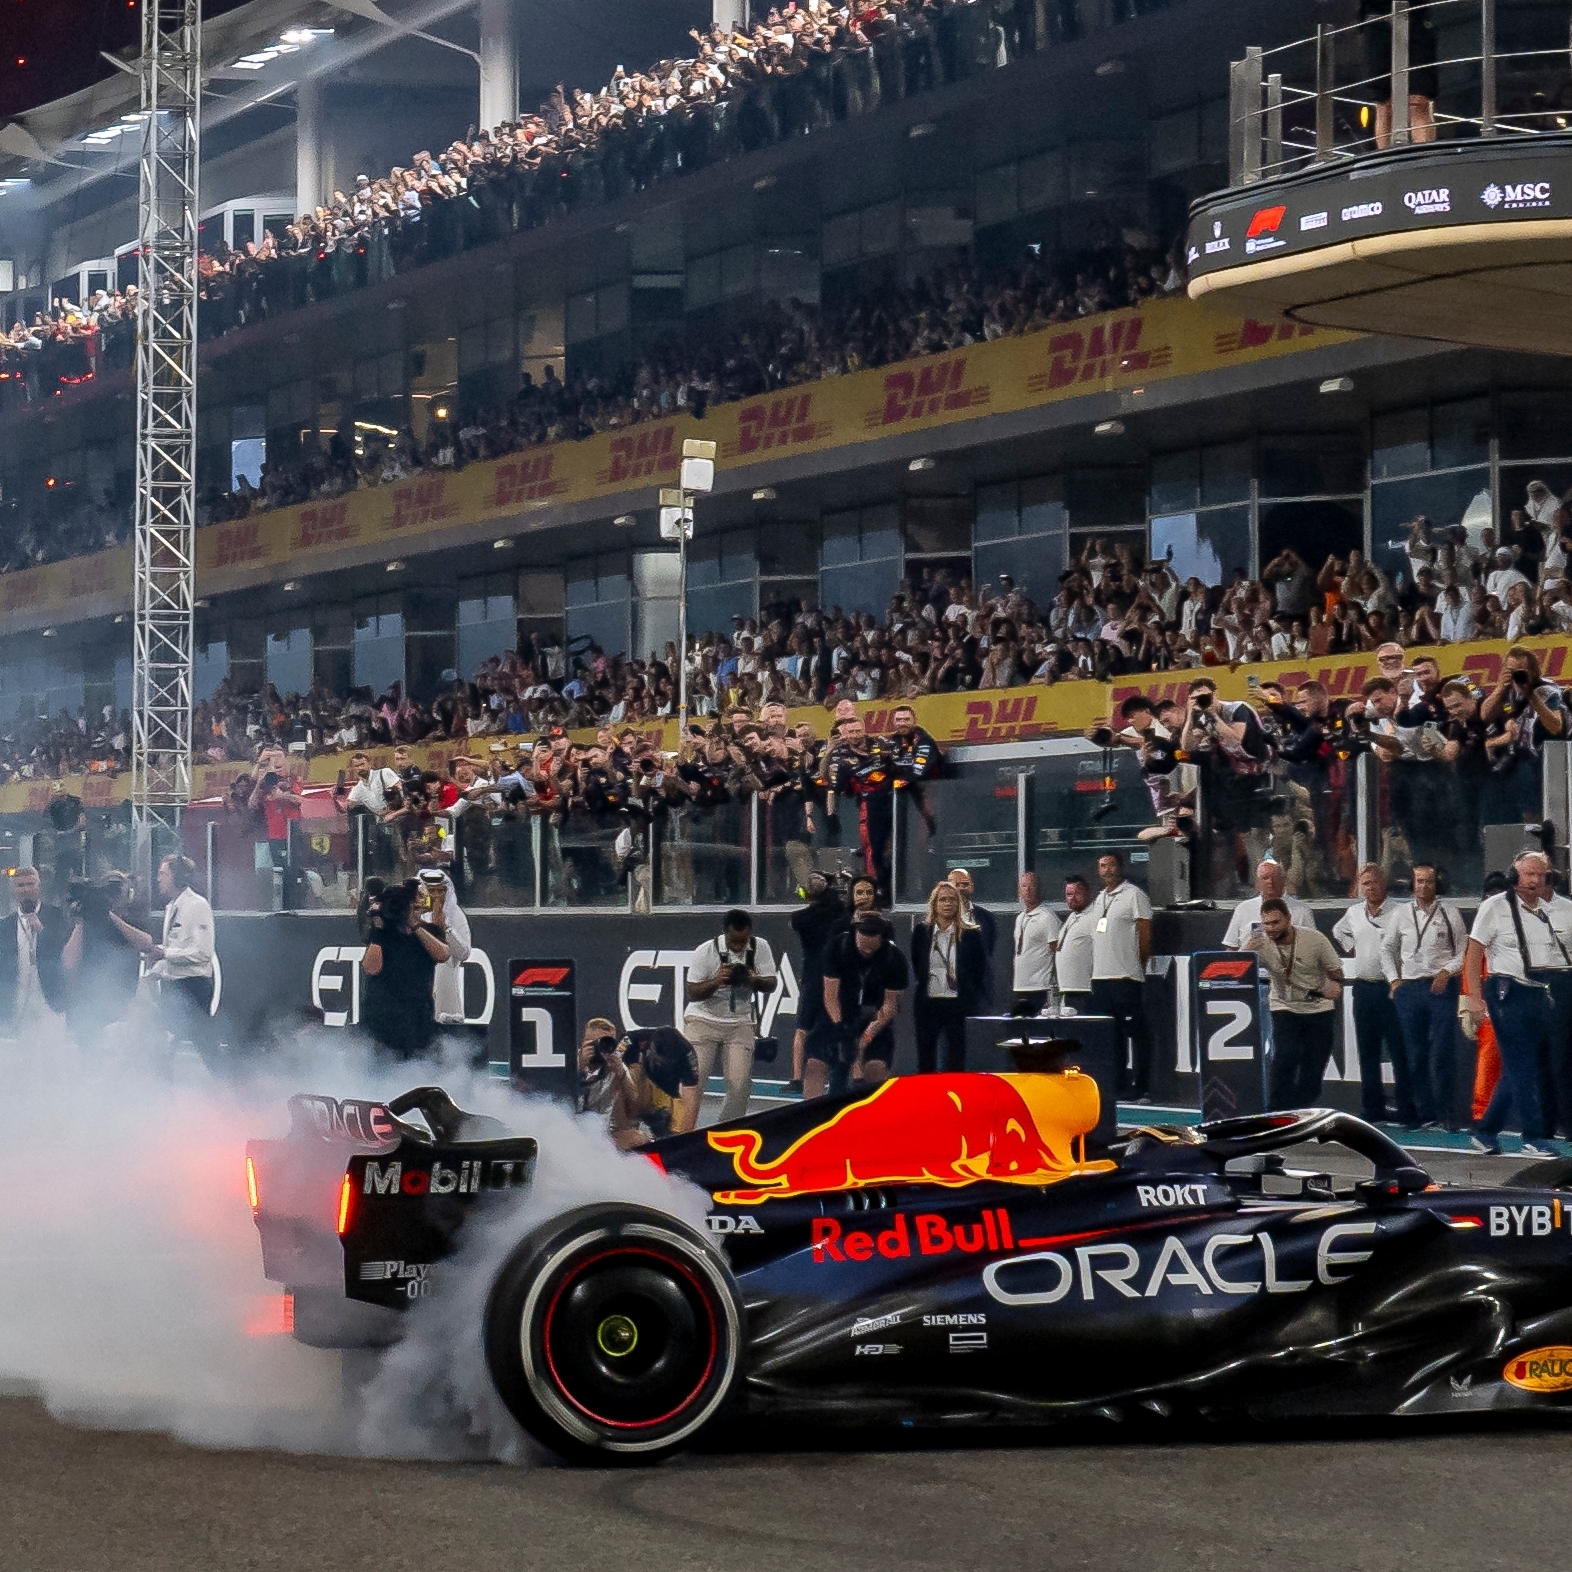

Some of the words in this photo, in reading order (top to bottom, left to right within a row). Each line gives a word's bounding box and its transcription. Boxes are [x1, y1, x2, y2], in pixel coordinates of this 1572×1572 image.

[1403, 188, 1450, 208] QATAR
[1504, 182, 1551, 201] MSC
[1046, 316, 1152, 390] DHL
[882, 357, 973, 427] DHL
[737, 392, 815, 457] DHL
[493, 453, 559, 508] DHL
[607, 428, 678, 485] DHL
[965, 695, 1039, 743] DHL
[311, 945, 495, 1027] ETD
[521, 1007, 566, 1068] 1
[1205, 1000, 1255, 1061] 2
[362, 1160, 483, 1195] Mobil
[1136, 1184, 1209, 1208] ROKT
[811, 1213, 911, 1264] Red
[916, 1207, 1015, 1256] Bull
[982, 1221, 1378, 1306] ORACLE
[922, 1312, 987, 1326] SIEMENS
